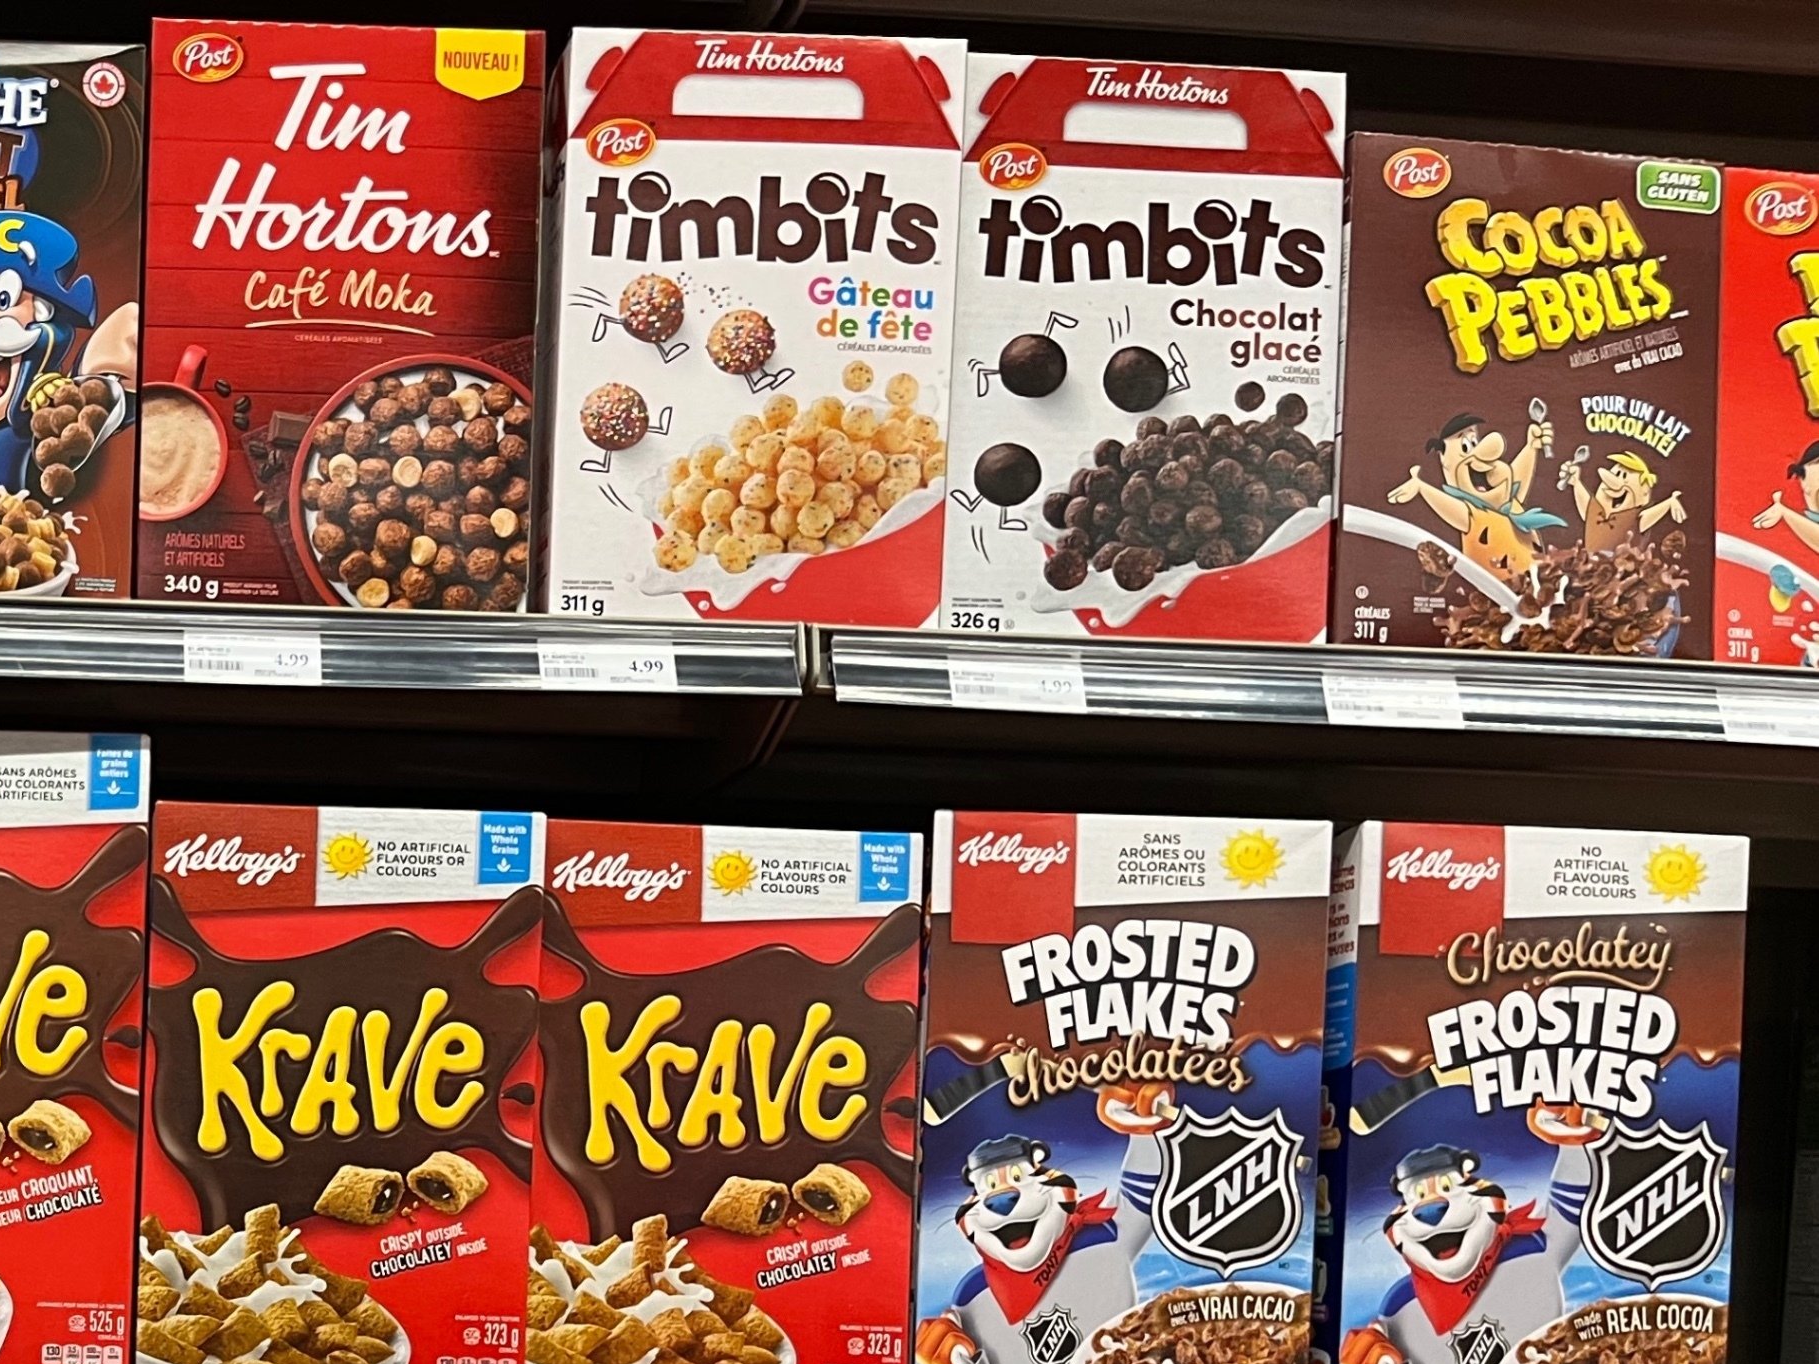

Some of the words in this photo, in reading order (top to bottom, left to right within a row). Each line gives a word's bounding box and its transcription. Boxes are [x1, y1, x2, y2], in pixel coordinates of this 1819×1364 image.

[185, 41, 230, 72] Post
[695, 39, 741, 69] Tim
[746, 40, 844, 73] Hortons
[1086, 67, 1130, 97] Tim
[1135, 68, 1228, 105] Hortons
[270, 64, 410, 153] Tim
[596, 127, 645, 158] Post
[989, 151, 1035, 180] Post
[1395, 156, 1438, 185] Post
[1658, 171, 1701, 186] SANS
[192, 157, 491, 257] Hortons
[1648, 185, 1709, 203] GLUTEN
[1758, 191, 1808, 222] Post
[585, 171, 938, 264] timbits
[1438, 199, 1646, 275] COCOA
[979, 195, 1325, 288] timbits
[245, 267, 329, 318] Café
[340, 269, 436, 315] Moka
[809, 277, 933, 309] Gâteau
[817, 310, 859, 339] de
[868, 310, 932, 341] fête
[1171, 299, 1321, 331] Chocolat
[1426, 260, 1673, 373] PEBBLES
[1230, 333, 1322, 367] glacé
[1582, 397, 1626, 415] POUR
[1630, 400, 1652, 419] UN
[1655, 408, 1690, 440] LAIT
[1586, 414, 1676, 456] CHOCOLATÉ!
[165, 576, 201, 593] 340
[205, 579, 219, 598] g
[629, 659, 663, 674] 4.99
[164, 833, 299, 885] Kellogg's
[958, 831, 1070, 874] Kellogg's
[1386, 846, 1500, 890] Kellogg's
[553, 850, 686, 901] Kellogg's
[1002, 920, 1255, 1002] FROSTED
[1446, 921, 1673, 991] Chocolatey
[1045, 982, 1234, 1051] FLAKES
[1428, 987, 1676, 1068] FROSTED
[1471, 1048, 1657, 1118] FLAKES
[1188, 1144, 1273, 1235] LNH
[1616, 1164, 1699, 1248] NHL
[1198, 1297, 1238, 1321] VRAI
[1243, 1296, 1295, 1321] CACAO
[1607, 1307, 1652, 1332] REAL
[1657, 1306, 1714, 1333] COCOA
